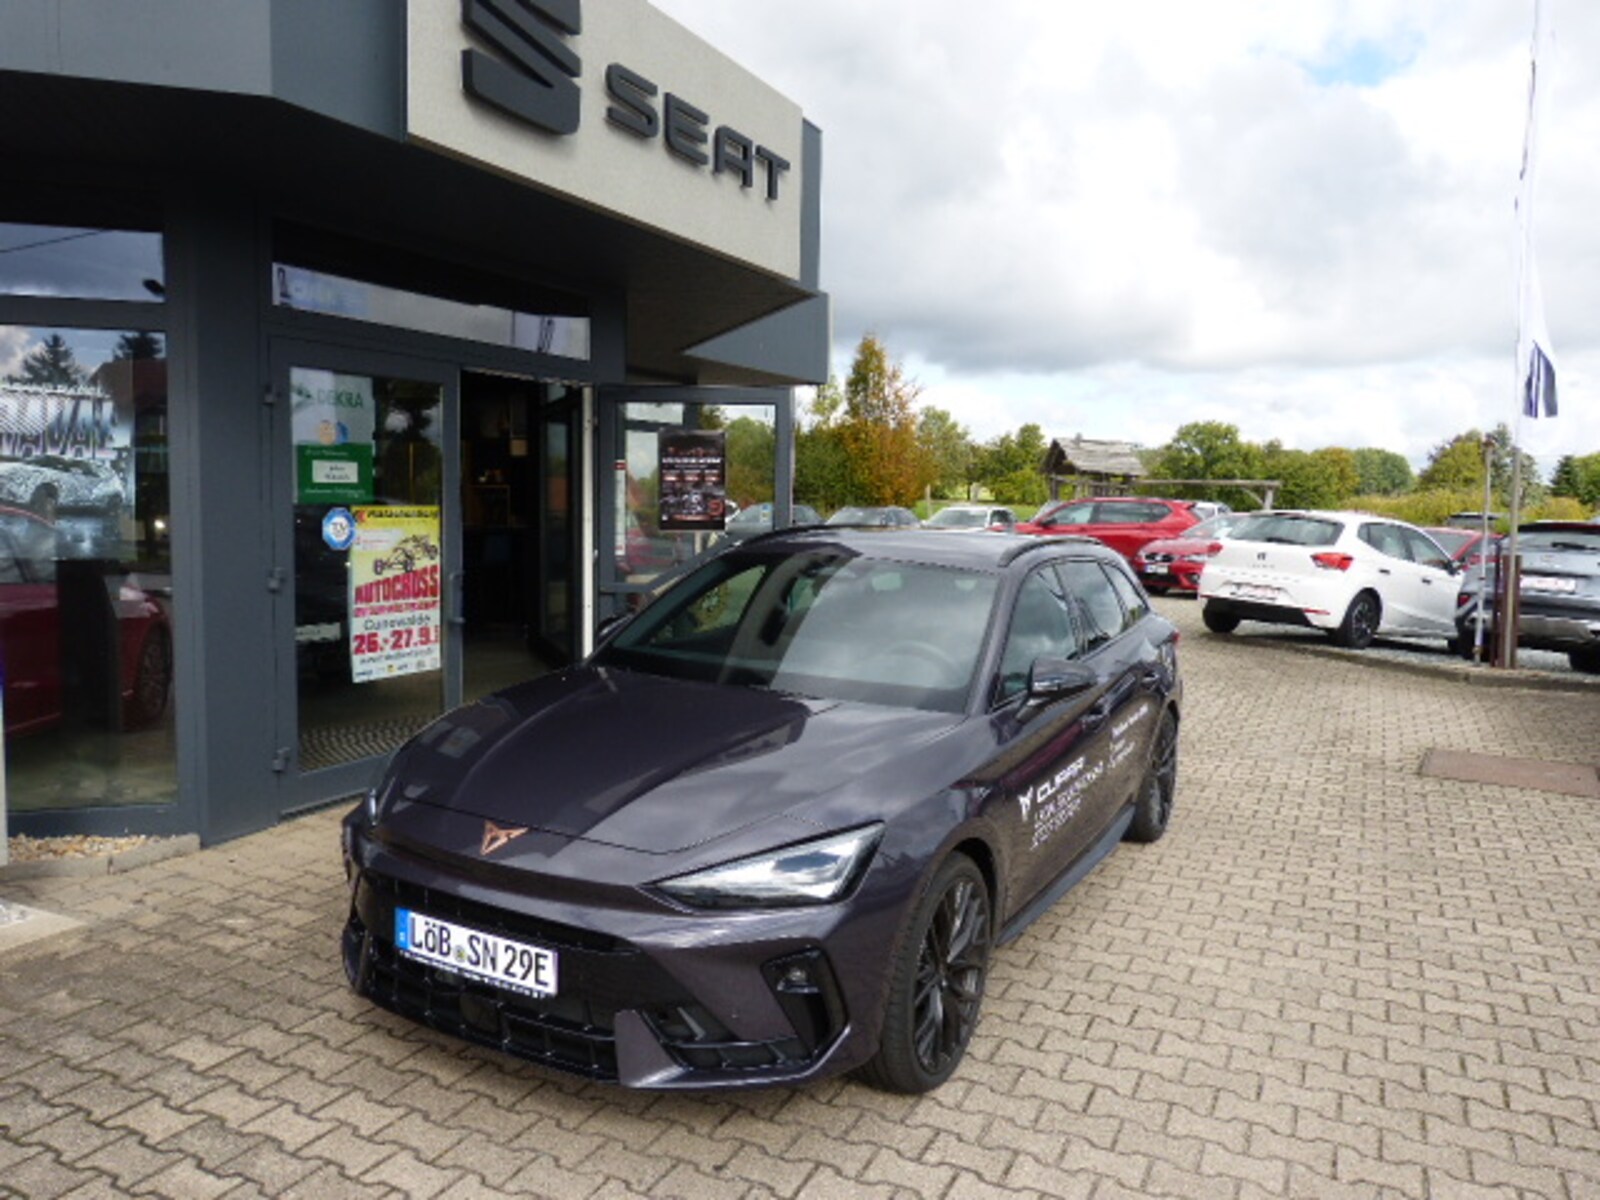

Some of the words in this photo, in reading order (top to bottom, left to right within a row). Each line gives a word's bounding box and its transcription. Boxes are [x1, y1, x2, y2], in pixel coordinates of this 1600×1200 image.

[605, 62, 791, 201] SEAT
[316, 389, 364, 409] DEKRA
[354, 565, 439, 605] AUTOCROSS
